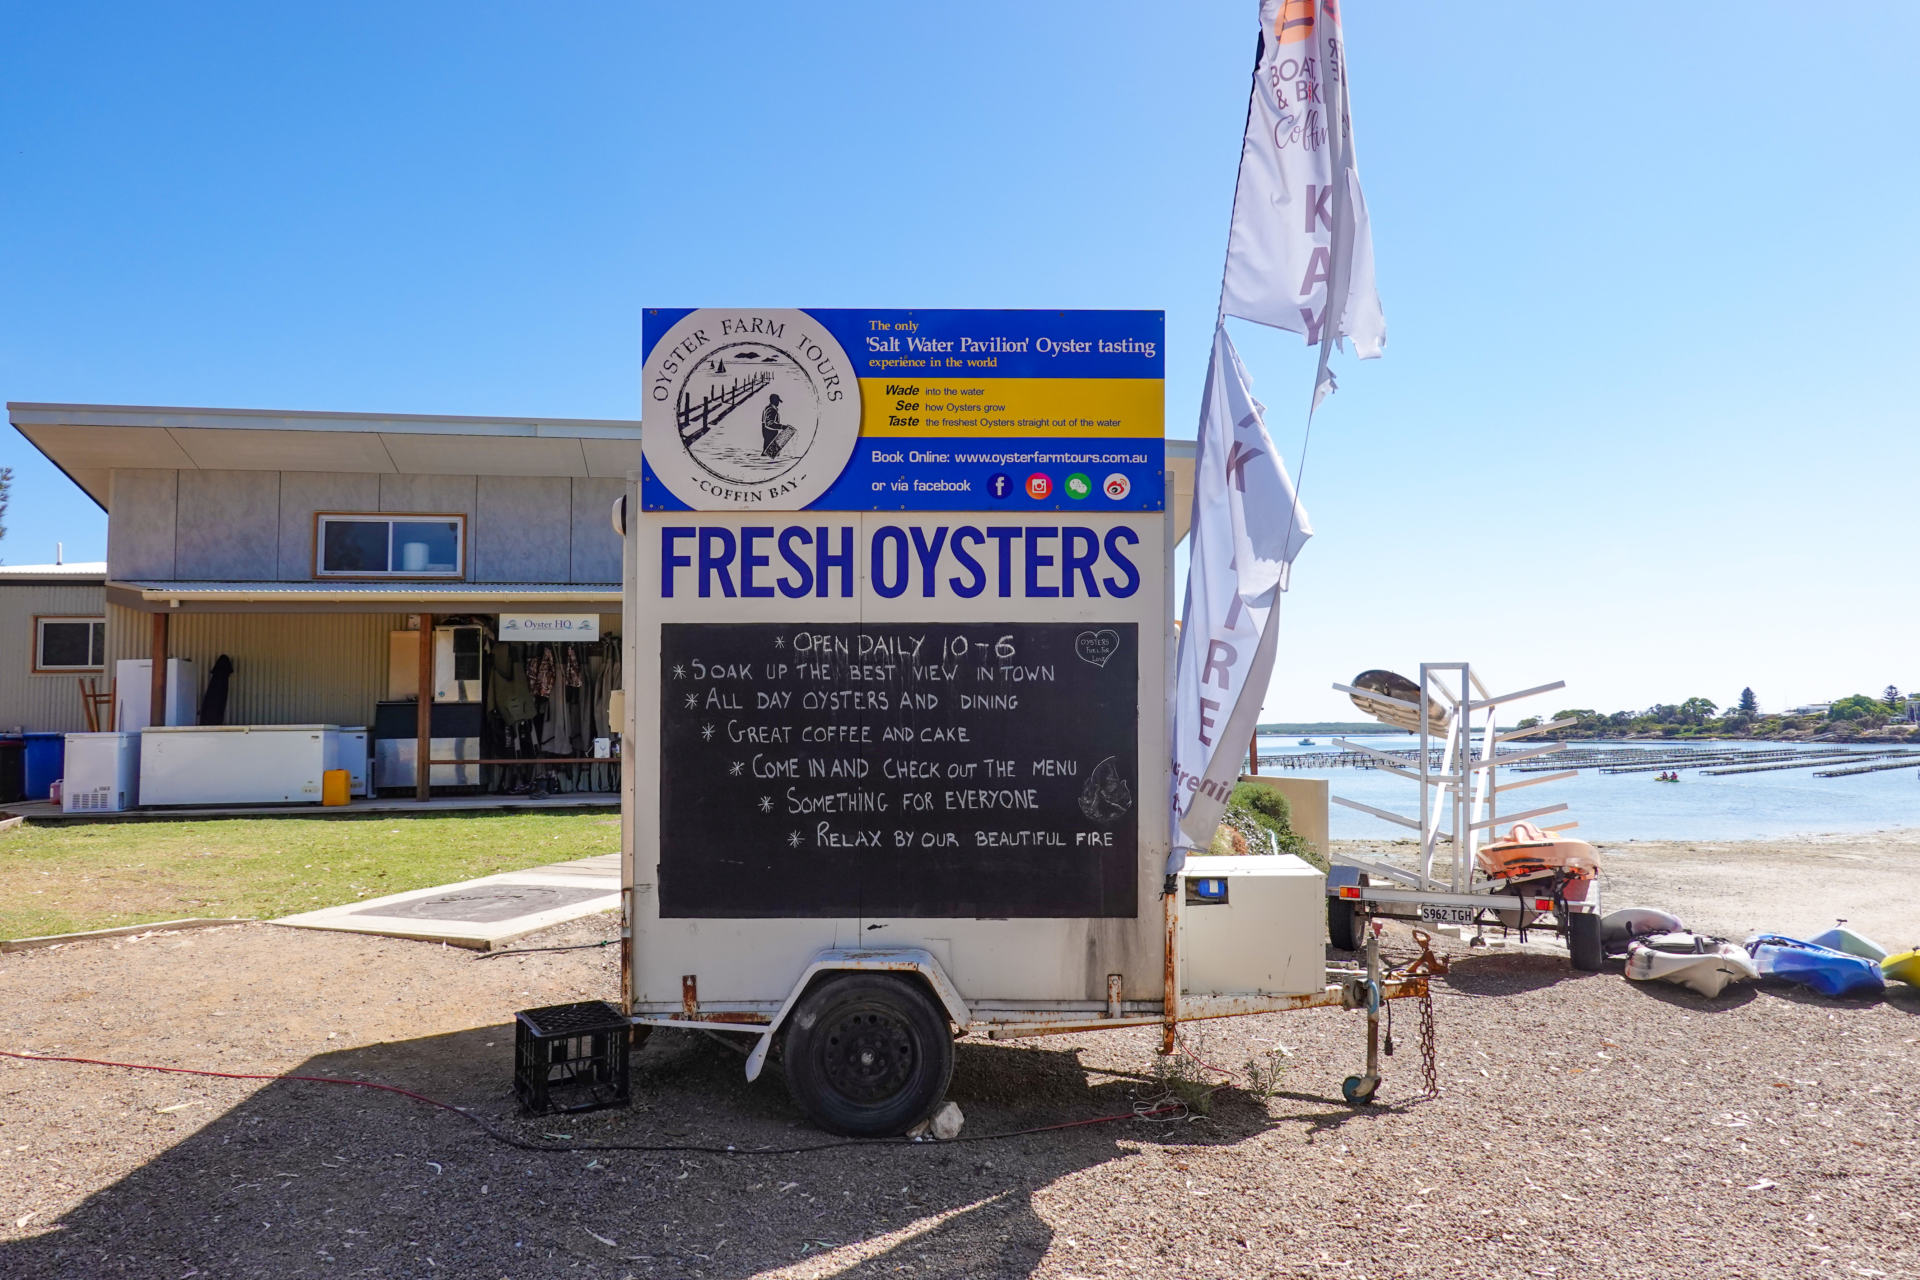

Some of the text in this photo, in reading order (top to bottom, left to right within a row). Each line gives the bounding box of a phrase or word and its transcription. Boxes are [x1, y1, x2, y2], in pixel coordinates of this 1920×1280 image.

[869, 320, 919, 333] The only
[906, 337, 953, 353] Water
[1036, 338, 1091, 358] Oyster
[1098, 339, 1156, 358] tasting
[653, 317, 843, 402] OYSTER FARM TOURS
[869, 357, 998, 370] experience in the world
[885, 385, 985, 396] Wade into the water
[895, 400, 1006, 414] See how Oysters grow
[888, 416, 1121, 429] Taste the freshest Oysters straight out of the water
[872, 451, 1148, 466] Book Online: www.oysterfarmtours.com.au
[871, 482, 886, 491] or
[891, 480, 909, 491] via
[913, 480, 971, 491] facebook
[661, 526, 1141, 598] FRESH OYSTERS
[524, 620, 552, 630] Oyster
[555, 620, 572, 629] HQ
[793, 632, 848, 654] OPEN
[857, 634, 926, 656] DAILY
[691, 658, 1054, 682] SOAK UP THE BEST VIEW IN TOWN
[705, 687, 1018, 710] ALL DAY OYSTERS AND DINING
[727, 720, 970, 744] GREAT COFFEE AND CAKE
[752, 753, 1077, 779] COME IN AND CHECK OUT THE MENU
[902, 791, 934, 811] FOR
[945, 788, 1039, 810] EVERYONE
[816, 821, 1113, 848] RELAX BY OUR BEAUTIFUL FIRE
[1423, 908, 1472, 921] S962 TGH
